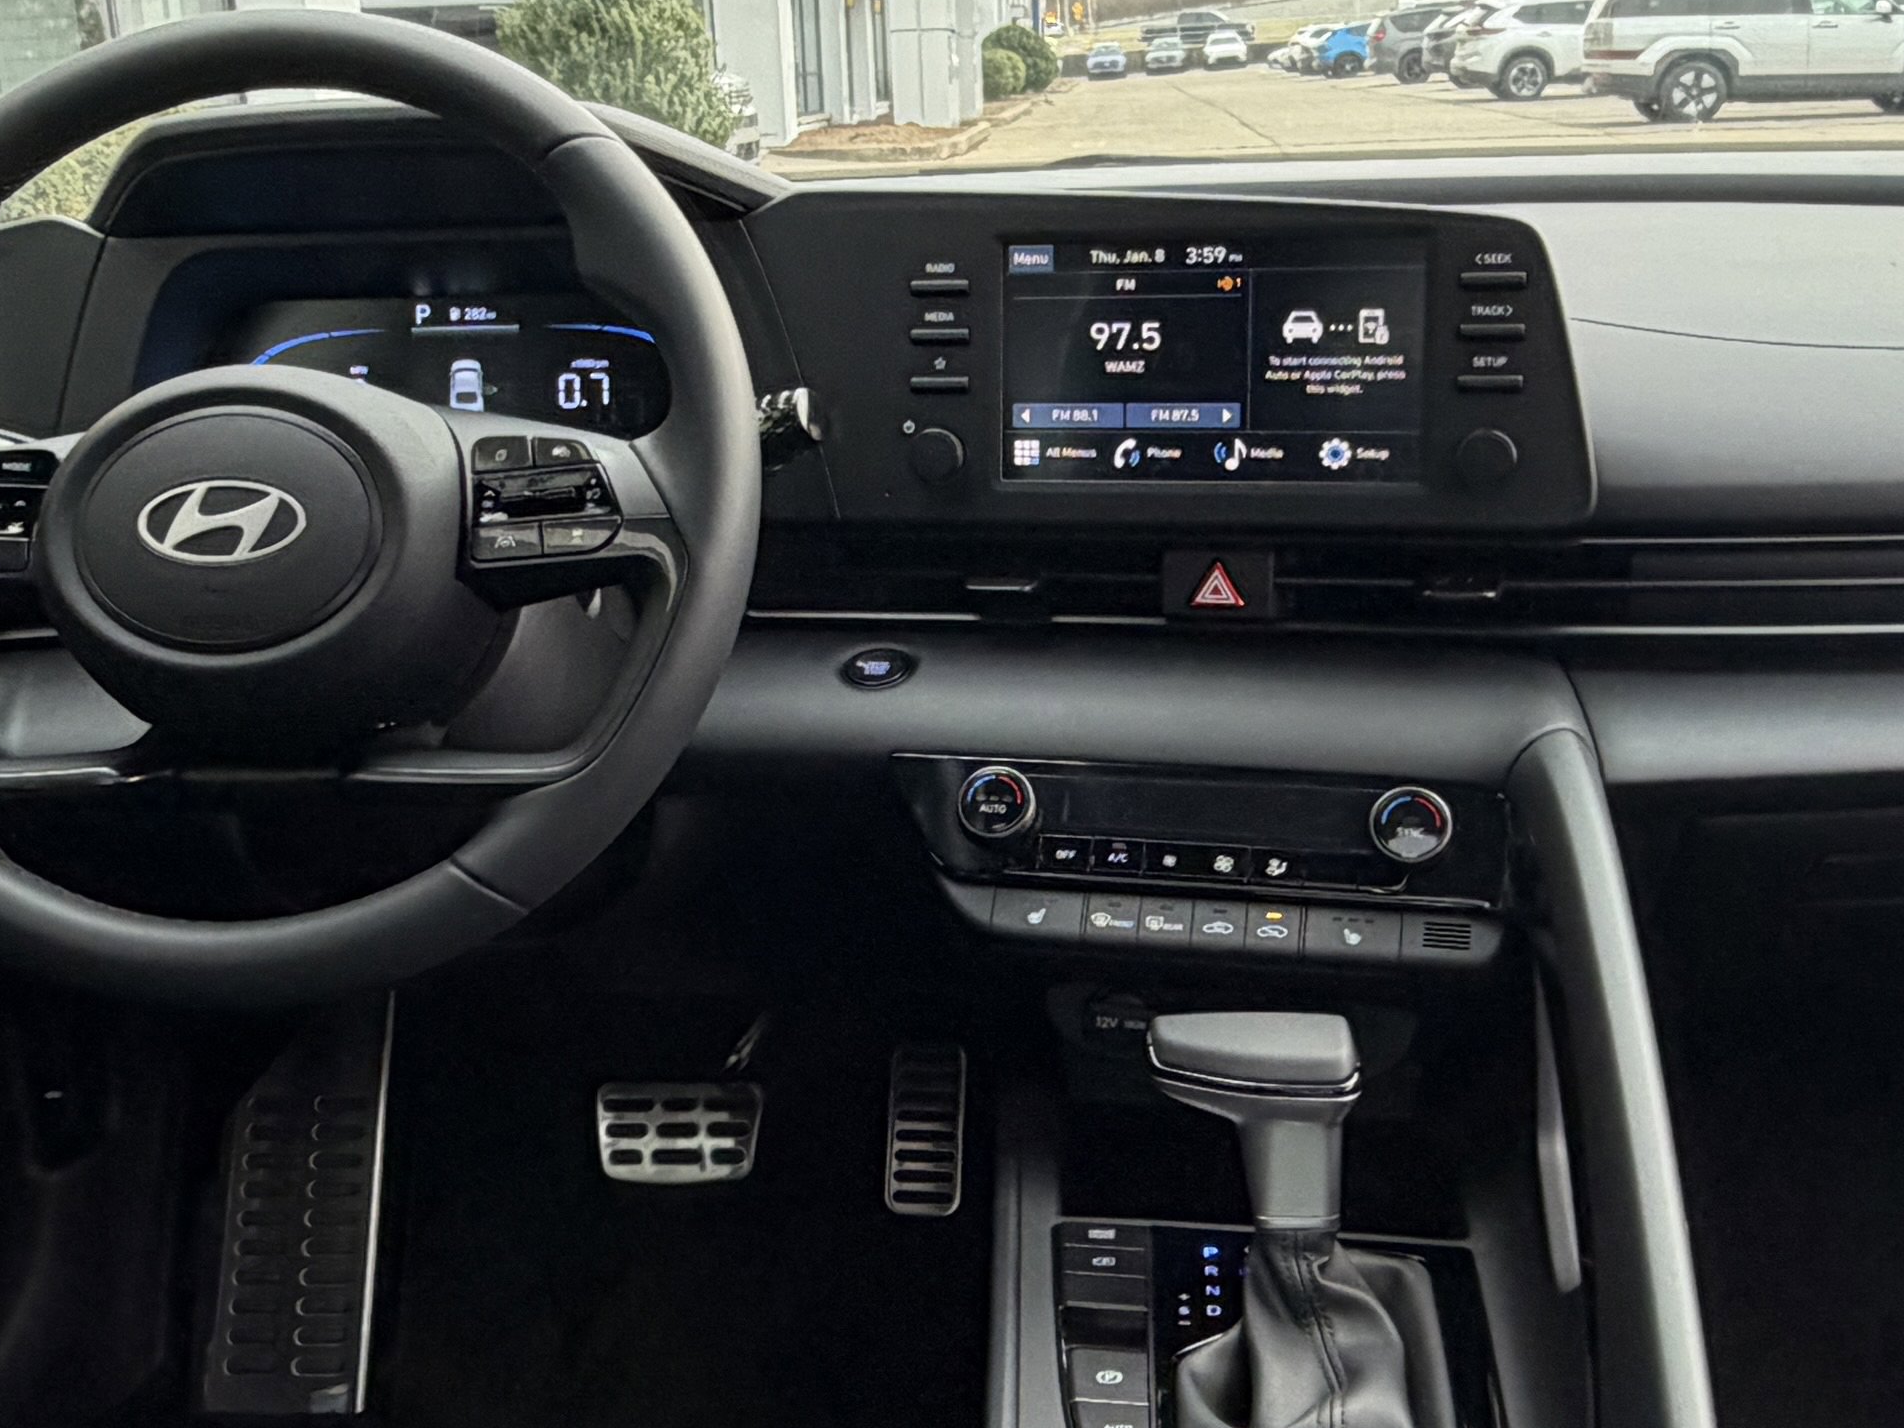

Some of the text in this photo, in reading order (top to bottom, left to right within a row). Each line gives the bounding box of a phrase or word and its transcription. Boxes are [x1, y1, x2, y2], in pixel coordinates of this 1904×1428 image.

[1013, 252, 1049, 267] Menu
[1090, 249, 1120, 265] Thu,
[1123, 249, 1152, 264] Jan.
[1155, 249, 1165, 263] 8
[1186, 247, 1227, 265] 3:59
[1116, 279, 1136, 291] FM
[415, 304, 432, 325] P
[924, 312, 954, 322] MEDIA
[1090, 323, 1161, 352] 97.5
[1105, 360, 1145, 373] WAMZ
[1269, 354, 1404, 367] To start connecting Android
[1265, 370, 1288, 380] Auto
[1291, 371, 1301, 380] or
[1304, 370, 1332, 382] Apple
[1376, 370, 1406, 381] press
[558, 372, 610, 410] 0.7
[1306, 384, 1363, 396] this widget.
[1052, 410, 1070, 421] FM
[1151, 410, 1199, 421] FM 87.5
[1046, 448, 1097, 458] All Menus
[1148, 448, 1182, 458] Phone
[1251, 448, 1284, 458] Media
[1357, 447, 1390, 460] Setup
[979, 803, 1007, 815] AUTO
[1107, 853, 1129, 864] A/C
[1202, 1246, 1219, 1260] P
[1203, 1265, 1219, 1276] R
[1205, 1285, 1221, 1296] N
[1205, 1304, 1222, 1316] D
